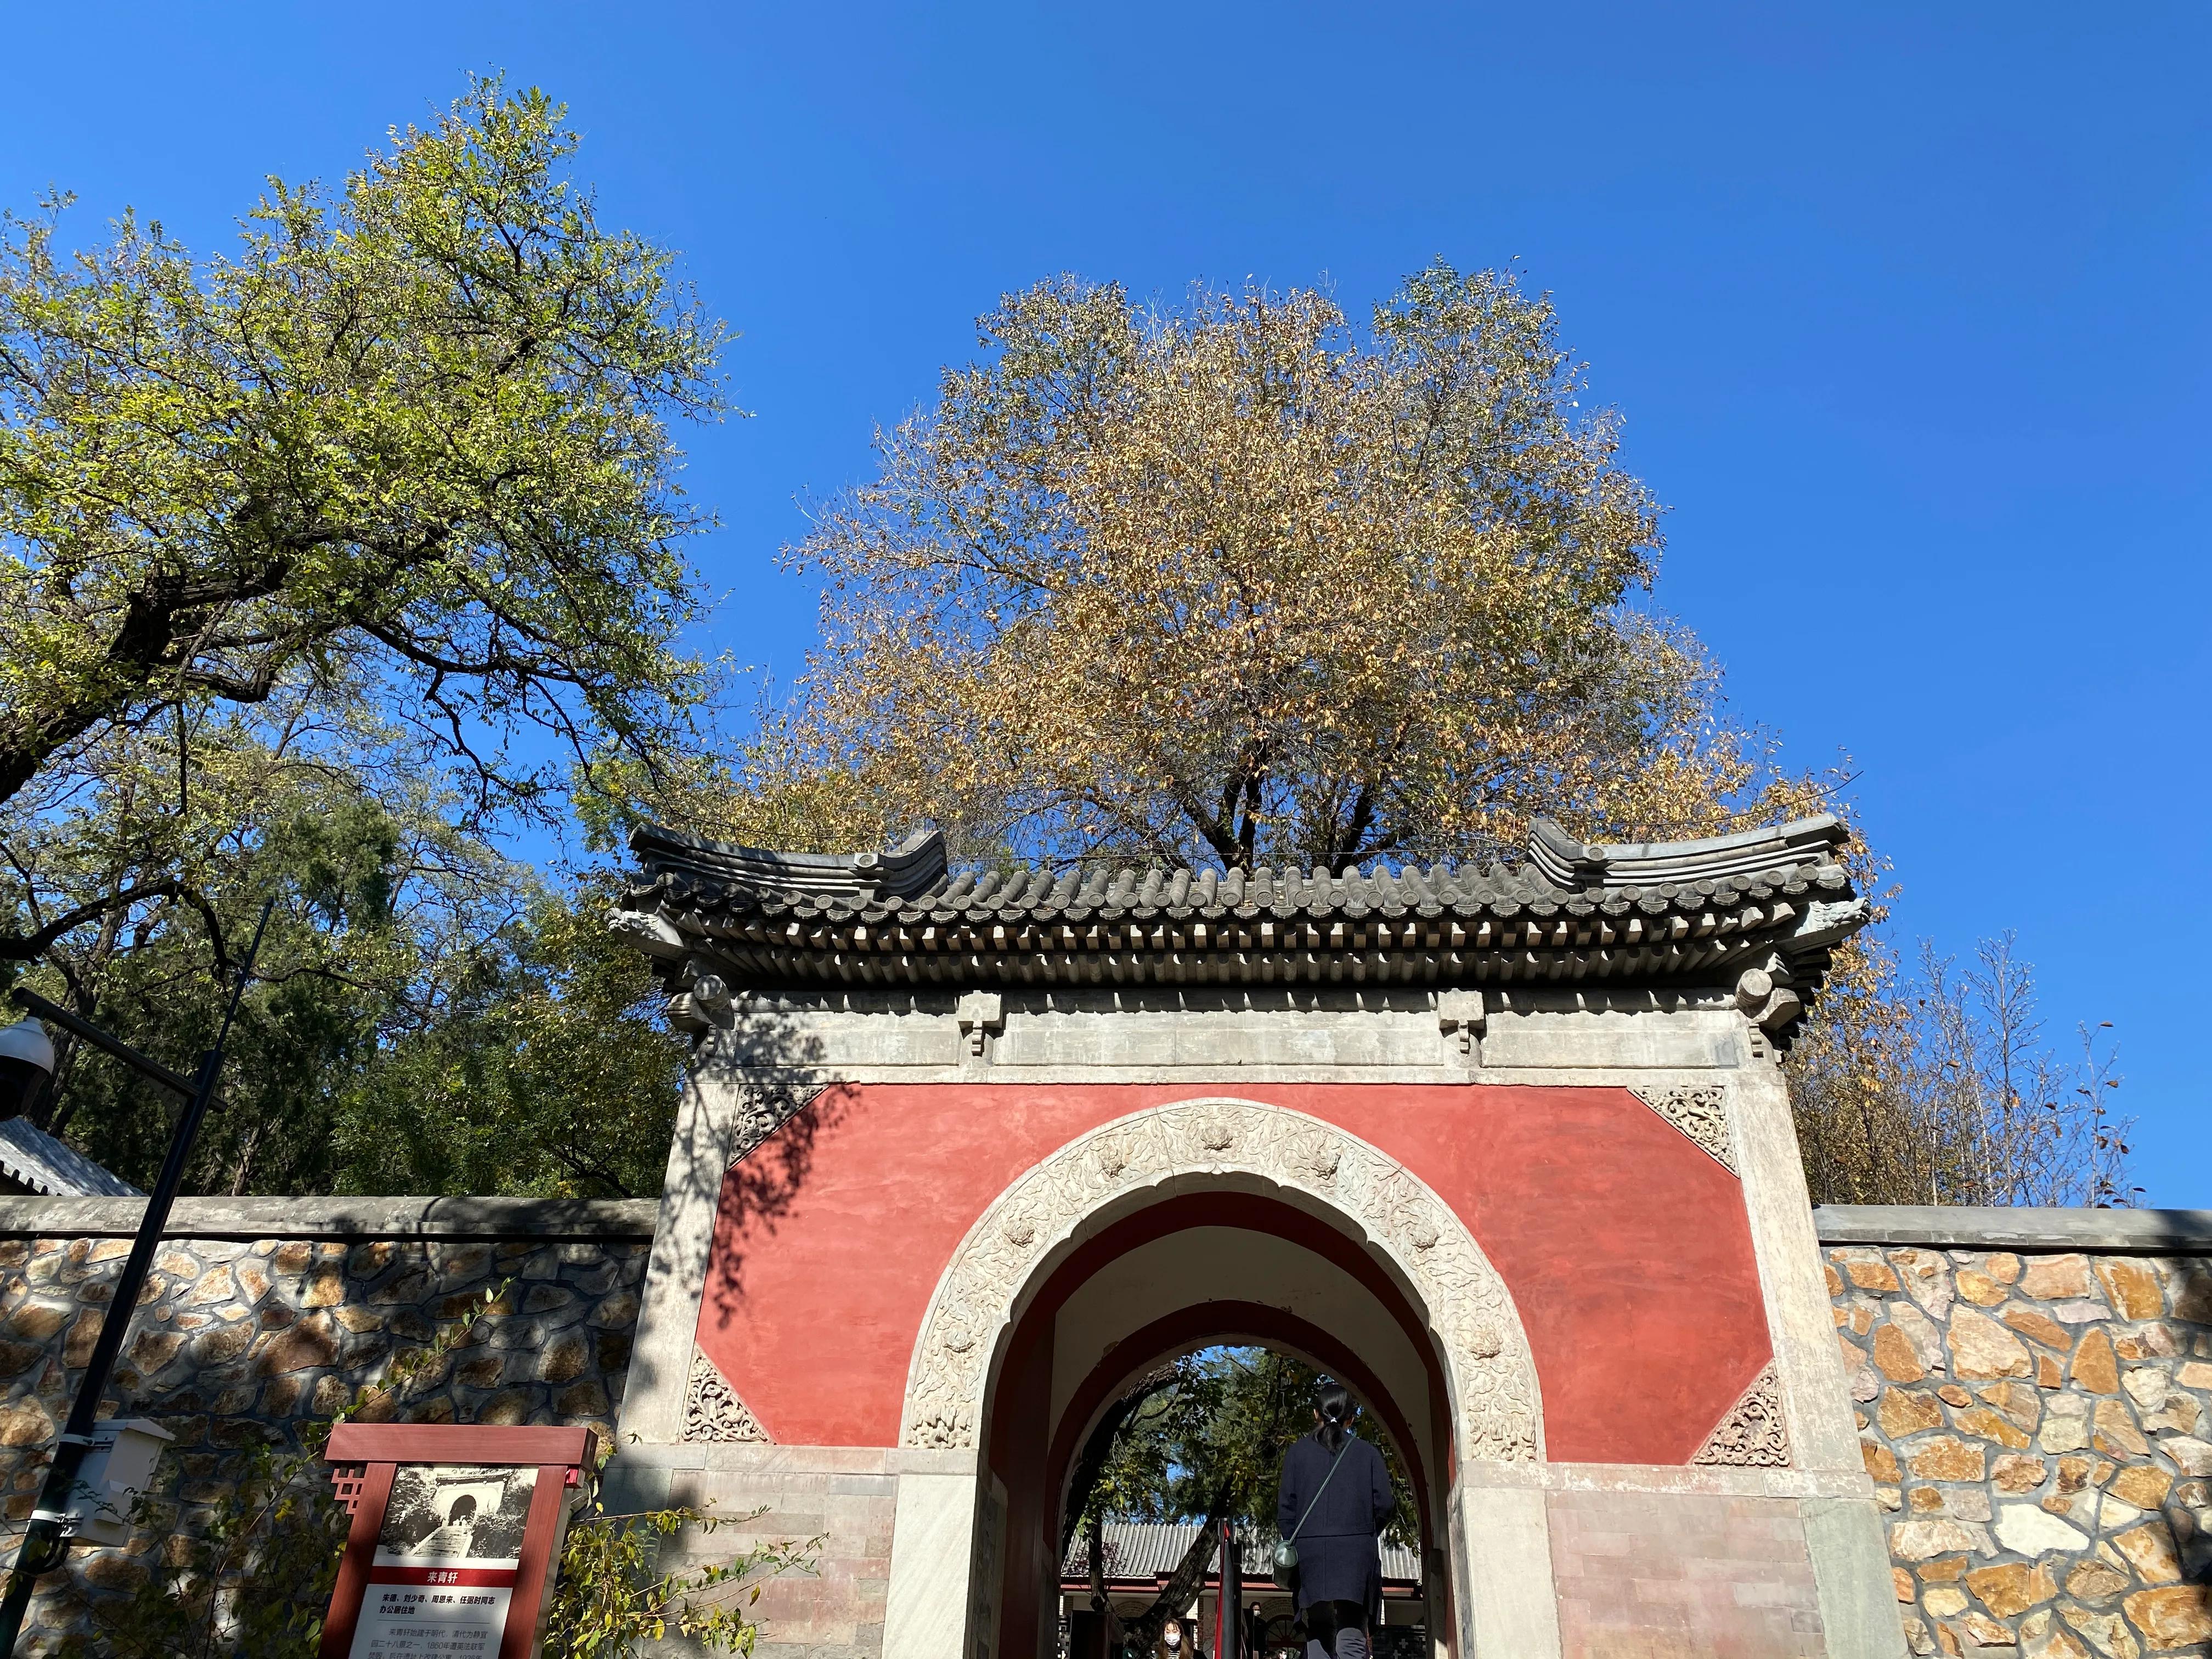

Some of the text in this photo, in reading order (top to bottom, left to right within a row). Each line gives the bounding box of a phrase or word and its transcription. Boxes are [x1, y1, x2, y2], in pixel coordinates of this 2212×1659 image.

[427, 1571, 458, 1583] 来青轩
[382, 1594, 495, 1605] 朱德、刘少奇、周恩来、任弼时同志
[380, 1605, 415, 1614] 办公居住地
